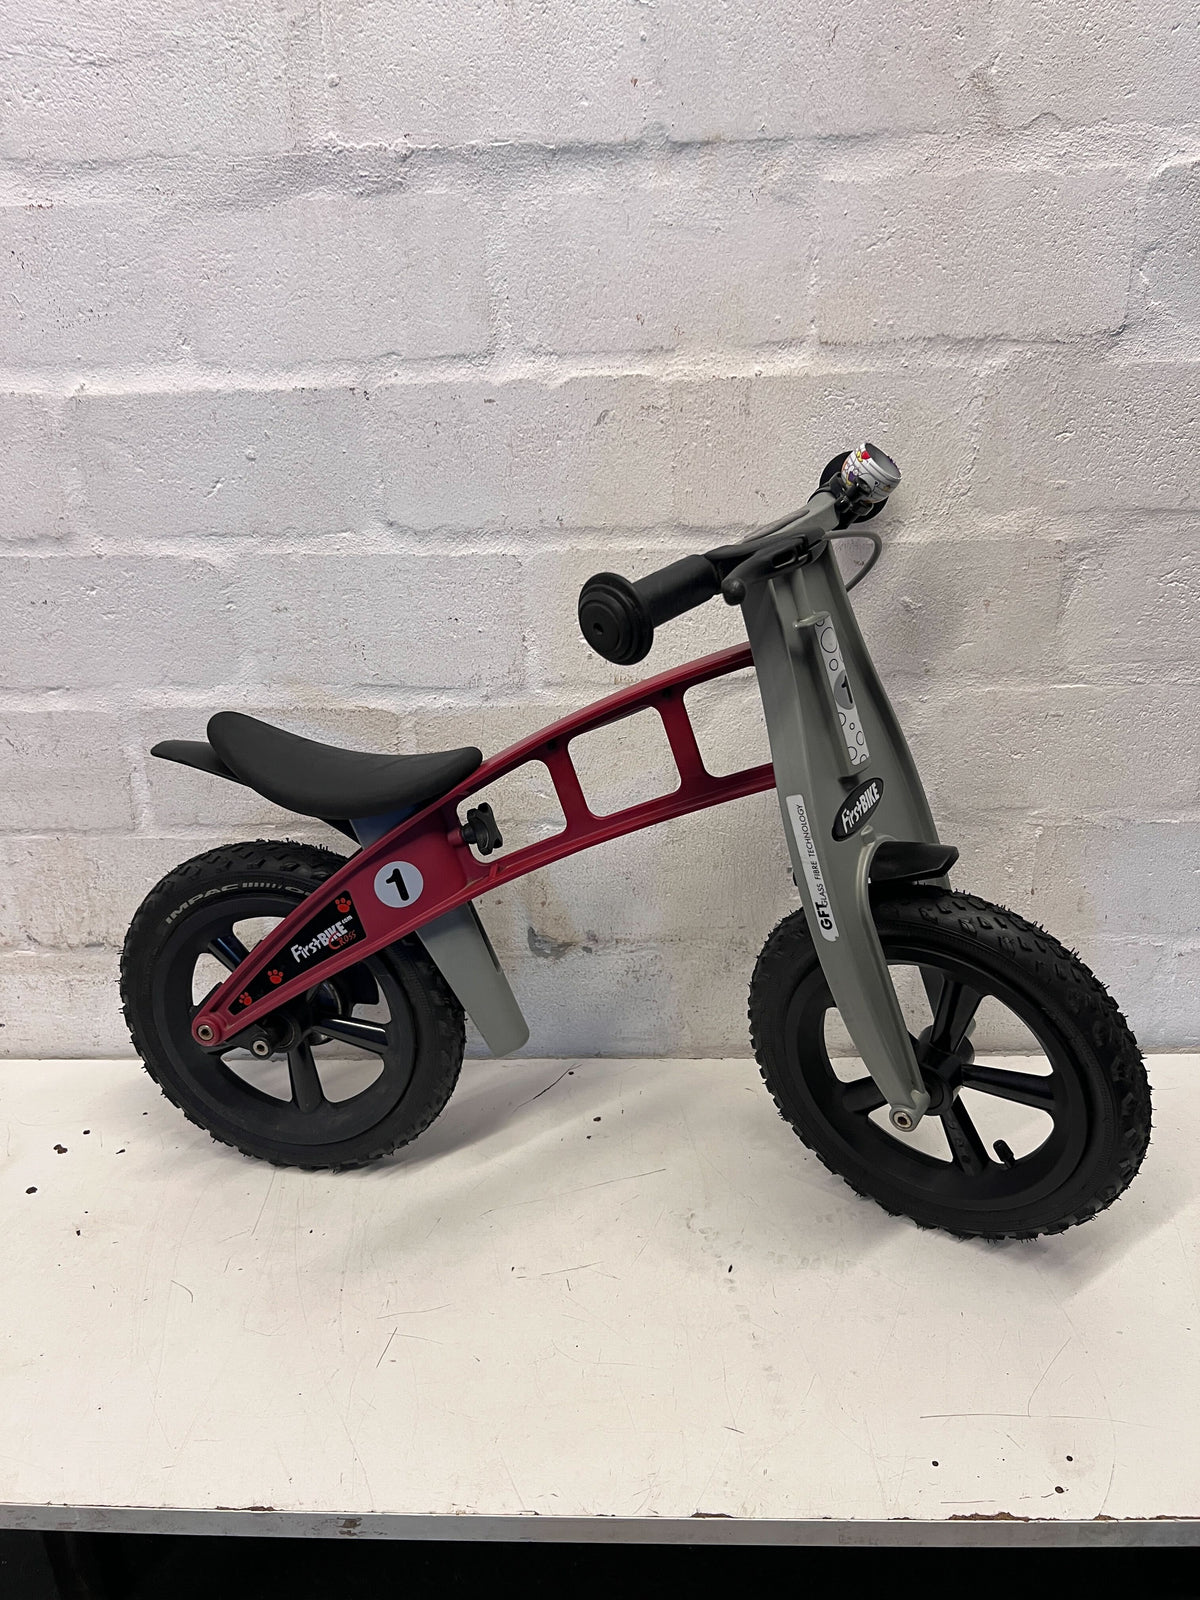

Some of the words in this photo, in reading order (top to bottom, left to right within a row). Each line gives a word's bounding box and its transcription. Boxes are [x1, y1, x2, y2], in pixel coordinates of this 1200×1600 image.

[841, 674, 853, 704] 1
[841, 782, 880, 834] FirstBIKE
[796, 804, 816, 857] TECHNOLOGY
[386, 868, 409, 901] 1
[811, 861, 822, 880] FIBRE
[165, 883, 239, 925] IMPAC
[816, 883, 829, 907] GLASS
[815, 902, 833, 930] GFT
